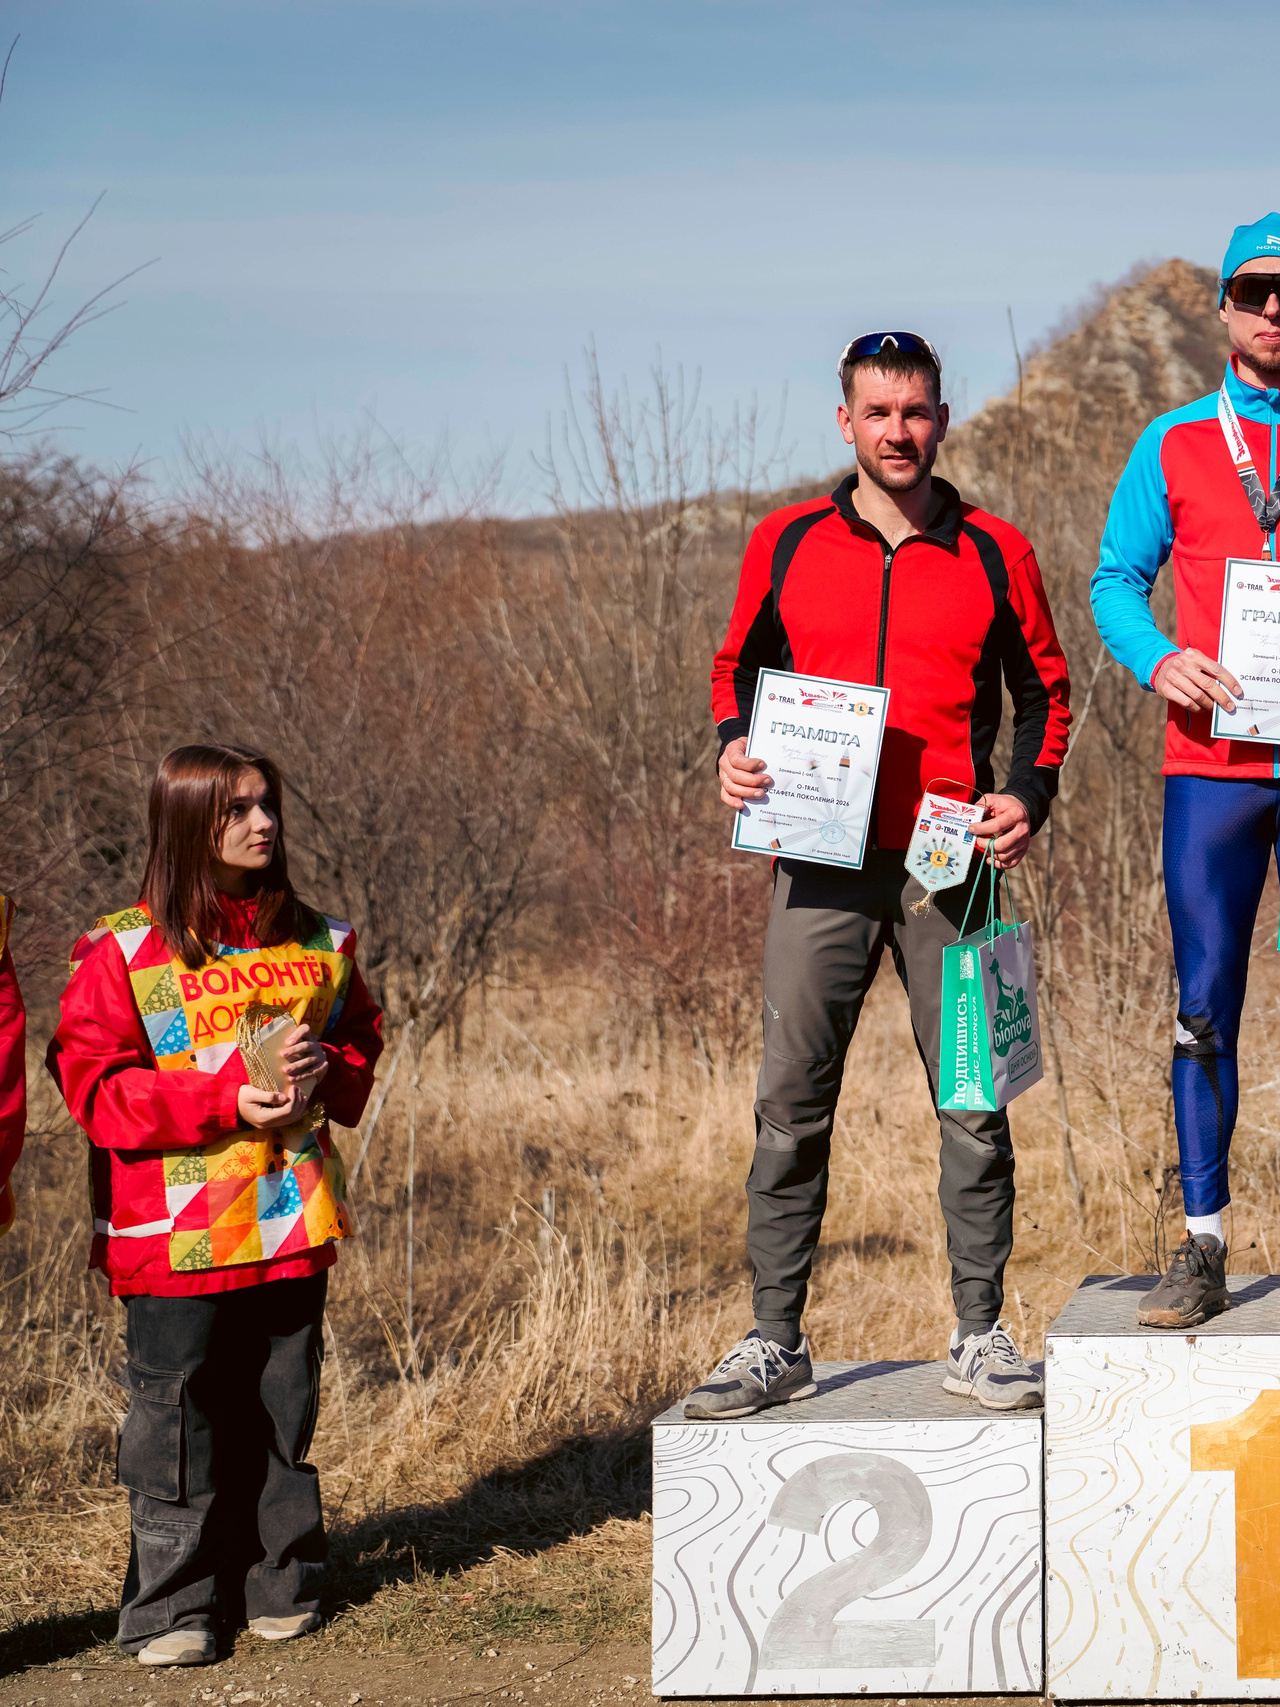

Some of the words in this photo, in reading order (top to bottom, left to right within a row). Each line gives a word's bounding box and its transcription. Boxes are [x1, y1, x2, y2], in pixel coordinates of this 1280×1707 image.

[1240, 674, 1270, 683] ЭСТАФЕТА
[770, 721, 861, 748] ГРАМОТА
[796, 783, 820, 793] O-TRAIL
[796, 792, 835, 804] ПОКОЛЕНИЙ
[836, 798, 850, 807] 2026
[179, 955, 333, 1002] ВОЛОНТЁР
[954, 992, 968, 1105] ПОДПИШИСЬ
[993, 1013, 1032, 1049] bionova
[972, 996, 983, 1106] PUBLIC_BIONOVA
[760, 1452, 936, 1668] 2
